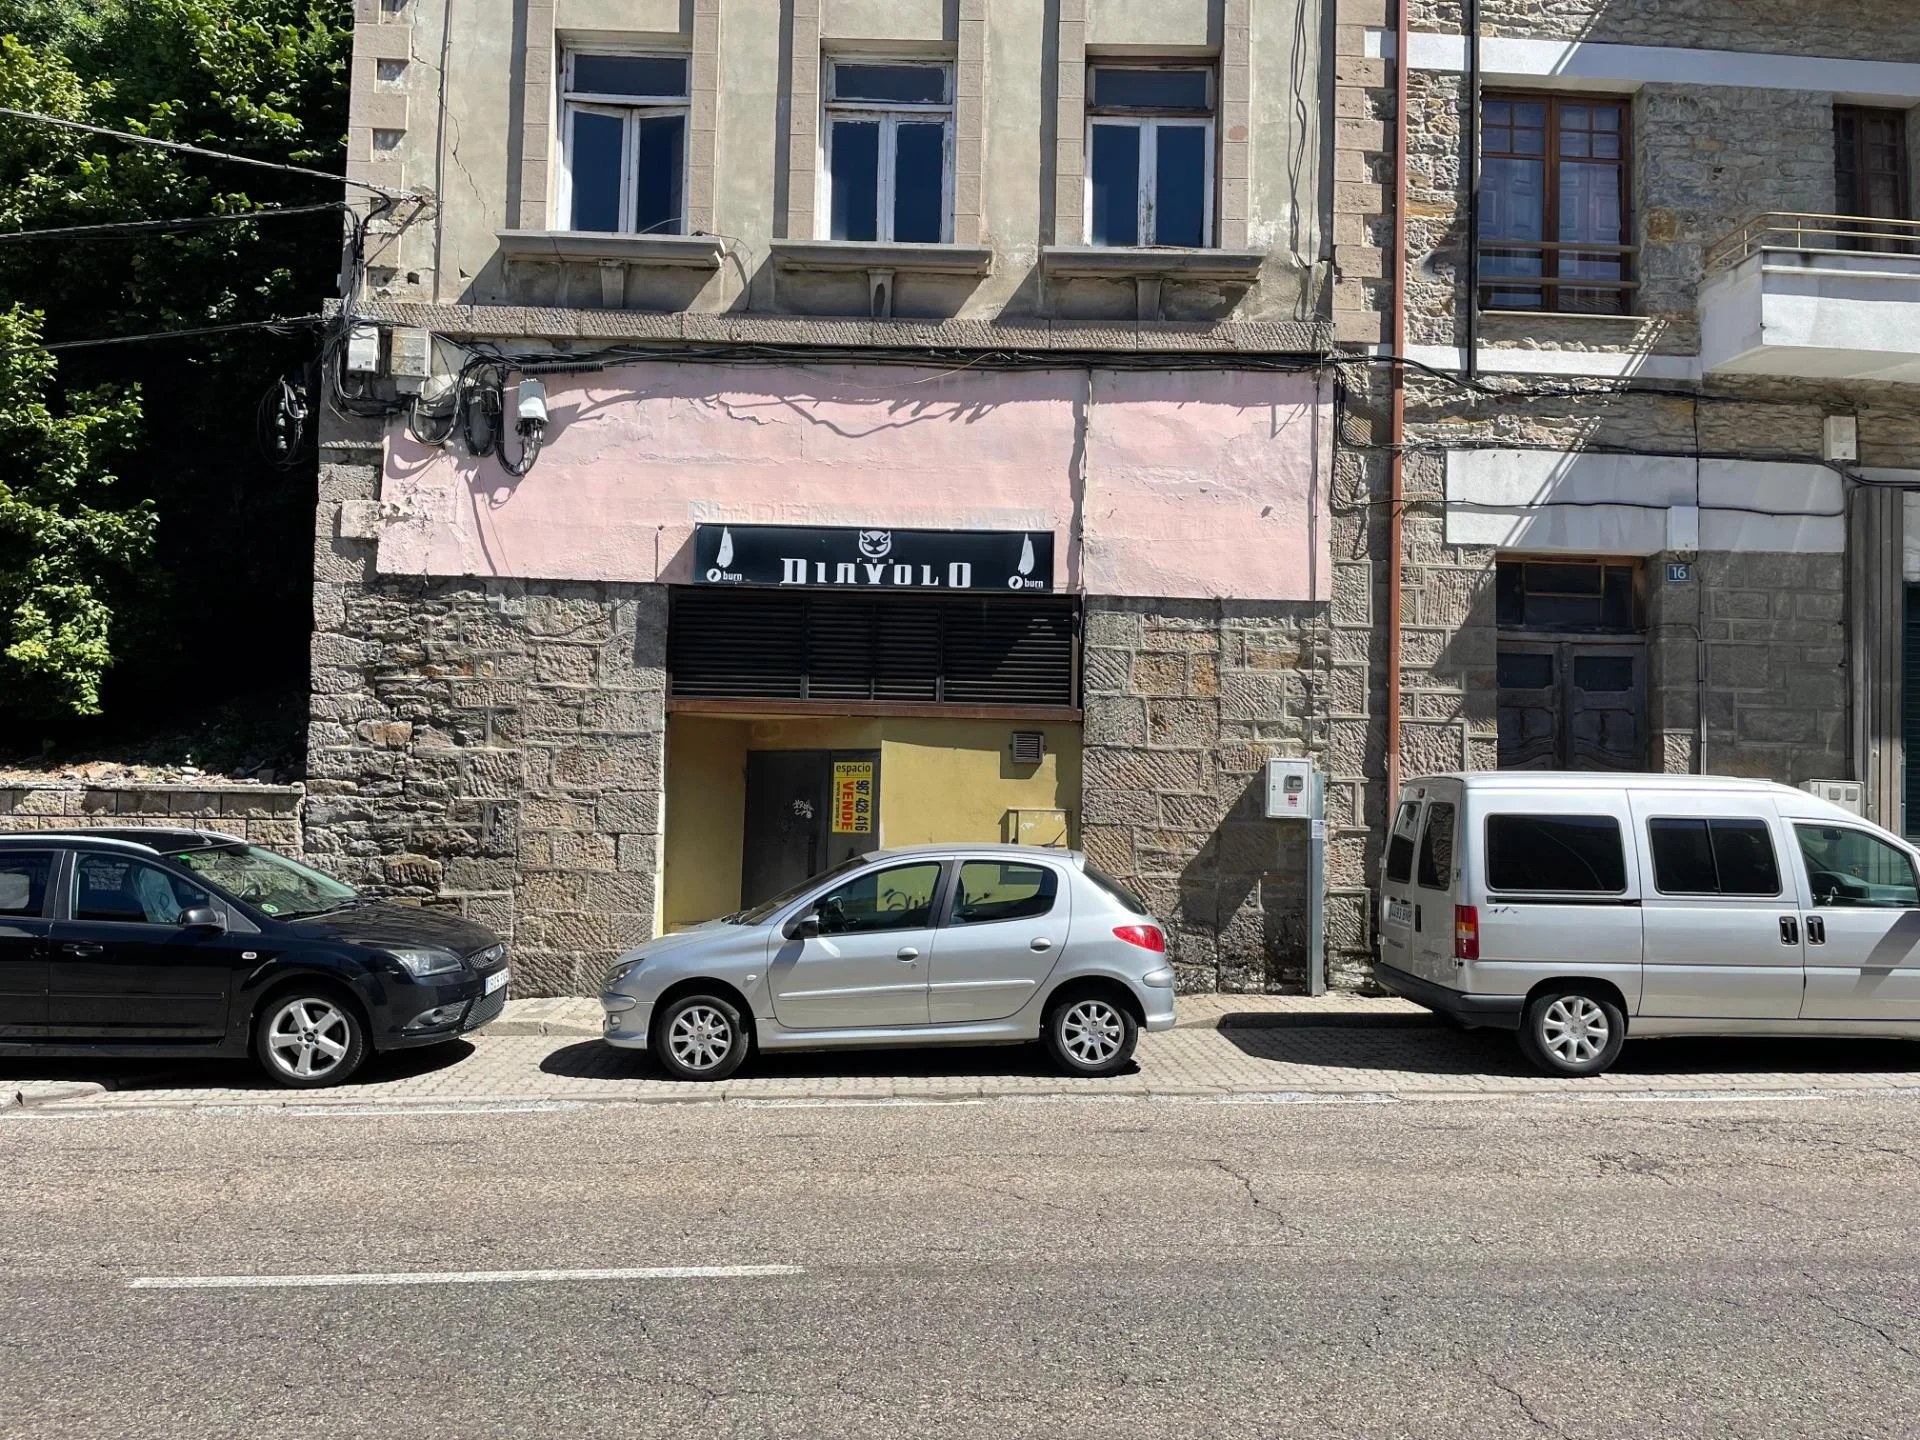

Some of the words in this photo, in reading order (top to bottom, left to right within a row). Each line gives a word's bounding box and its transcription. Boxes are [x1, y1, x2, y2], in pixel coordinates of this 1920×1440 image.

[722, 570, 743, 582] burn
[1672, 566, 1687, 579] 16
[1024, 577, 1044, 589] burn
[836, 763, 871, 776] espacio
[856, 780, 870, 796] 987
[842, 781, 855, 831] VENDE
[855, 798, 869, 814] 428
[855, 815, 869, 832] 416
